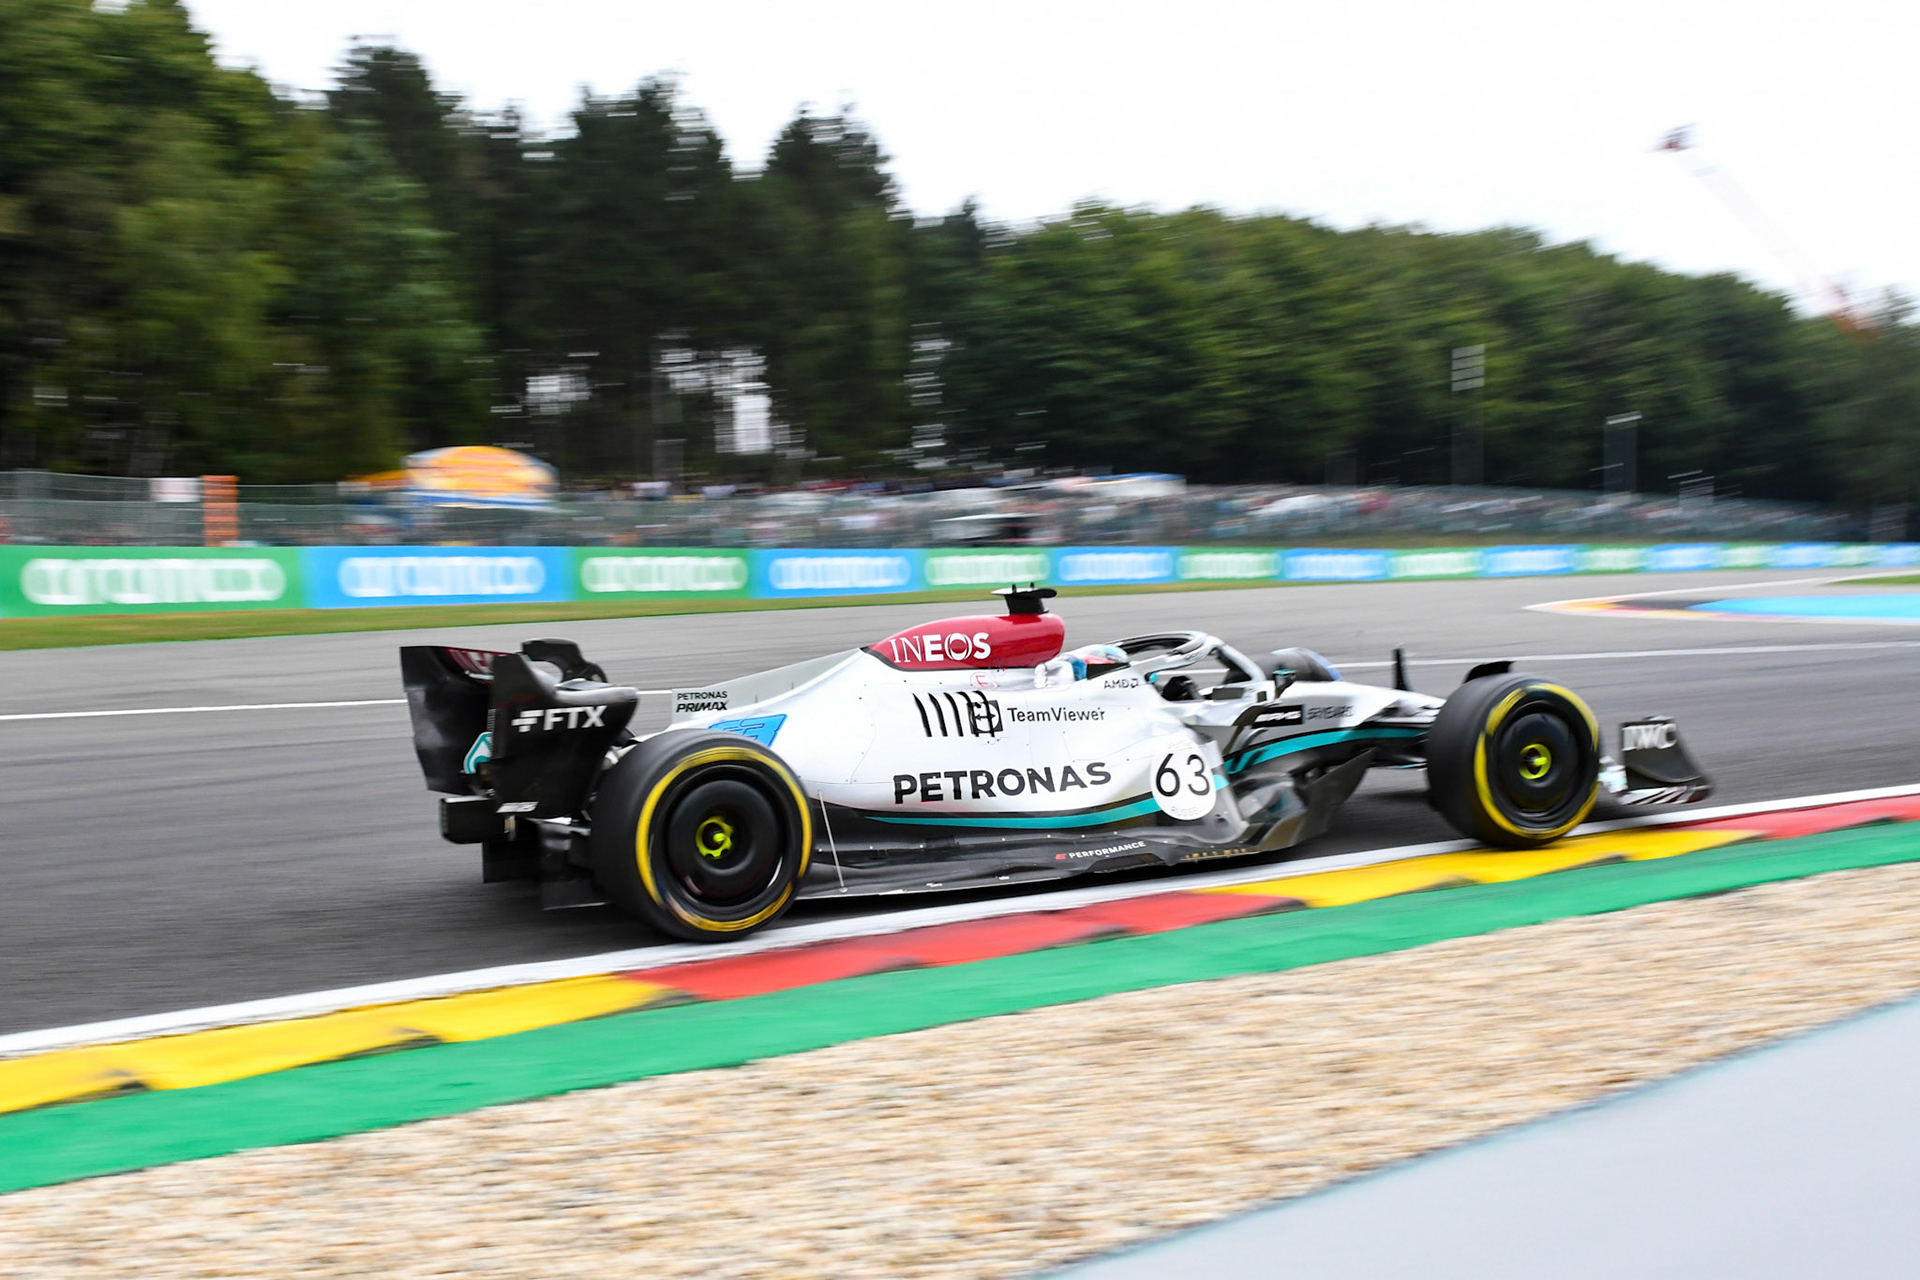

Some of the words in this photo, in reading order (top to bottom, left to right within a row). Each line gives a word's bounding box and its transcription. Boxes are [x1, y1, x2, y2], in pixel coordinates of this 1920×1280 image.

[889, 632, 991, 663] INEOS
[675, 701, 728, 713] PRIMAX
[676, 691, 728, 701] PETRONAS
[543, 705, 608, 731] FTX
[1007, 707, 1105, 722] TeamViewer
[1621, 723, 1678, 752] IWC
[893, 761, 1112, 805] PETRONAS
[1155, 752, 1211, 798] 63
[1068, 840, 1147, 859] PERFORMANCE
